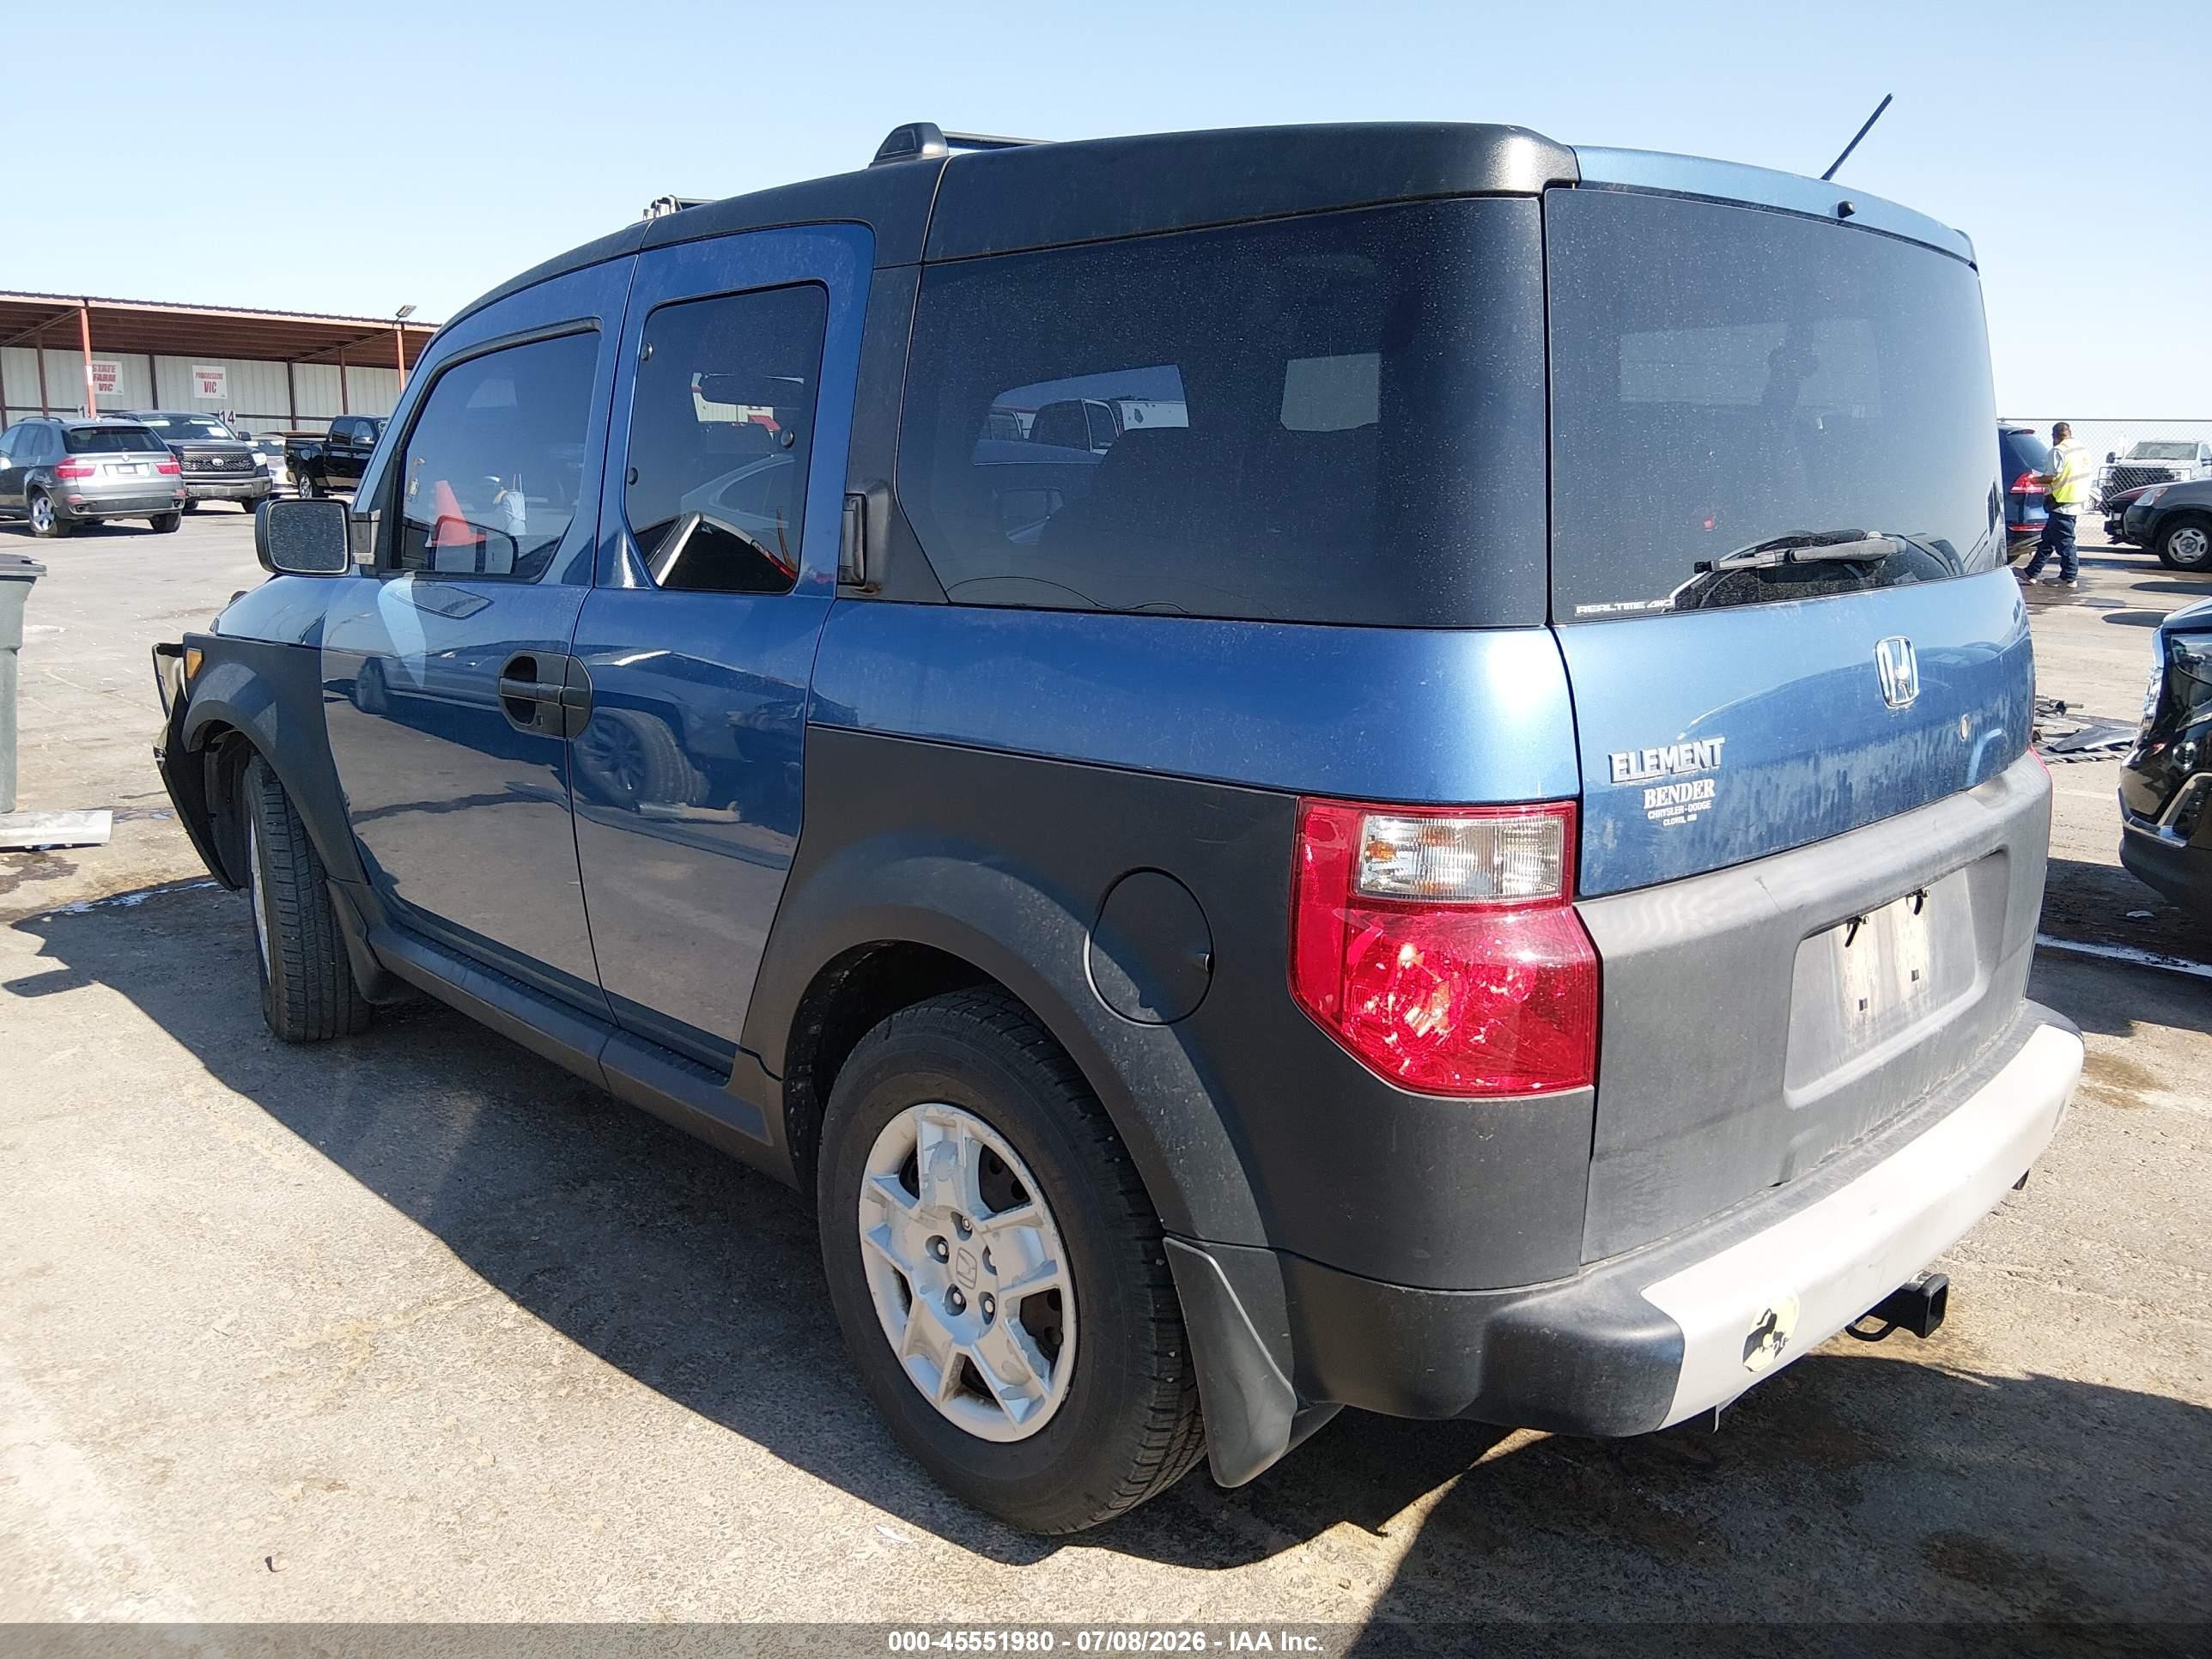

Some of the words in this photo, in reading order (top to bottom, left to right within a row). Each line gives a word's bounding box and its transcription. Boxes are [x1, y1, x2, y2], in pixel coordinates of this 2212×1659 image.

[92, 364, 117, 373] STATE
[93, 374, 116, 382] FARM
[98, 383, 114, 392] VIC
[204, 380, 217, 393] VIC
[220, 410, 235, 425] 14
[1608, 737, 1725, 783] ELEMENT
[1643, 779, 1717, 809] BENDER
